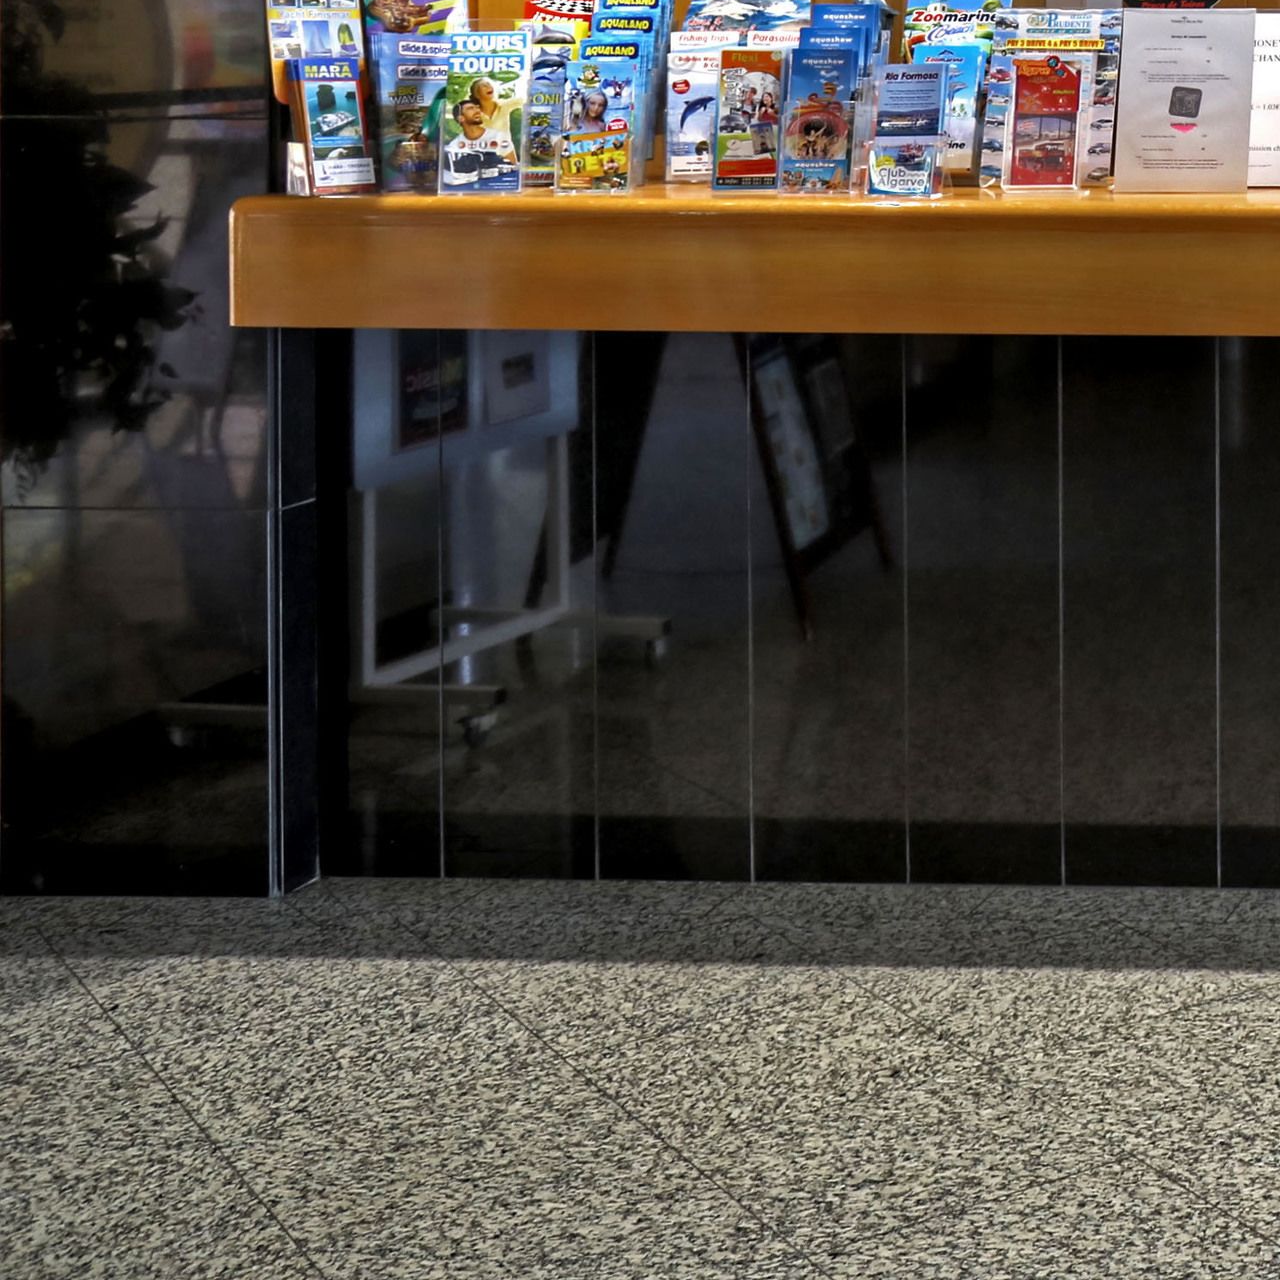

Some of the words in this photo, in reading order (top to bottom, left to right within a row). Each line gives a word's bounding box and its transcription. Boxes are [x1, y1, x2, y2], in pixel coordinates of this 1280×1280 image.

[823, 12, 866, 20] aquashow
[912, 10, 996, 23] Zoomarine
[600, 19, 650, 30] AQUALAND
[453, 35, 524, 51] TOURS
[753, 33, 800, 42] Parasailin
[810, 36, 853, 44] aquashow
[586, 45, 636, 56] AQUALAND
[450, 57, 521, 73] TOURS
[304, 64, 353, 78] MARA
[885, 72, 899, 81] Ria
[900, 72, 938, 80] Formosa
[391, 94, 424, 105] WAVE
[879, 167, 906, 178] Club
[877, 176, 925, 188] Algarve
